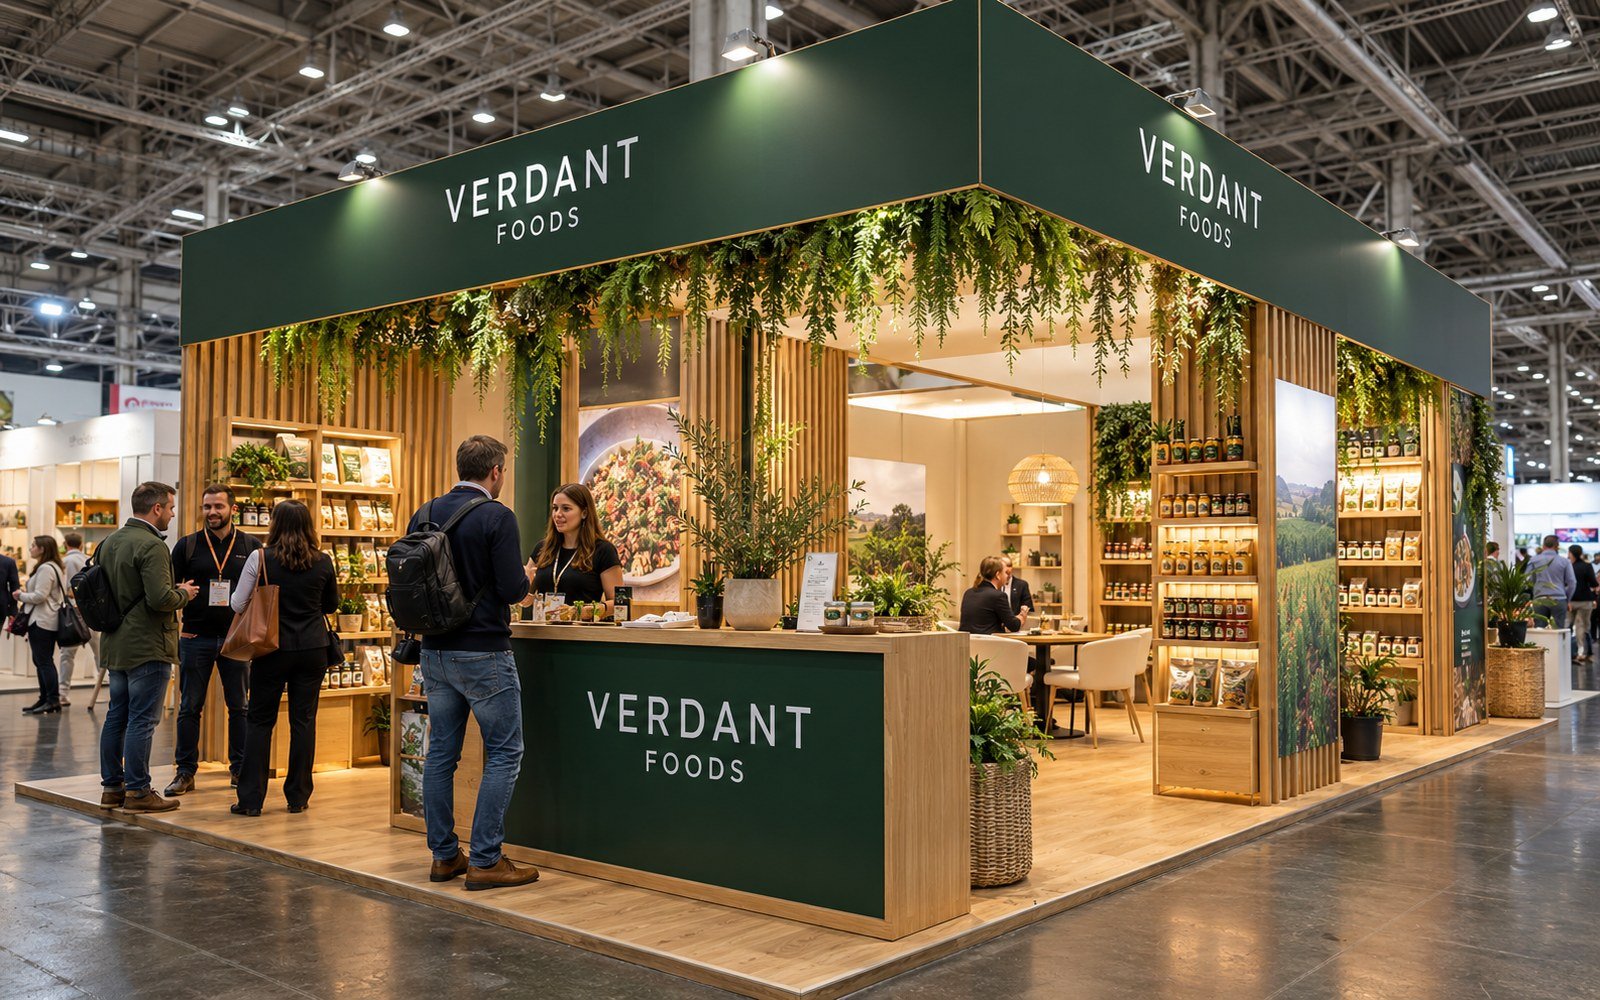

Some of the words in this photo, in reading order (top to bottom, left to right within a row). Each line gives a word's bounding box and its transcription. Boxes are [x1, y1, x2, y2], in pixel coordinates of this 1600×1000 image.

[445, 135, 639, 223] VERDANT
[1139, 127, 1262, 229] VERDANT
[496, 206, 580, 245] FOODS
[1179, 205, 1232, 249] FOODS
[587, 691, 812, 749] VERDANT
[645, 749, 744, 783] FOODS
